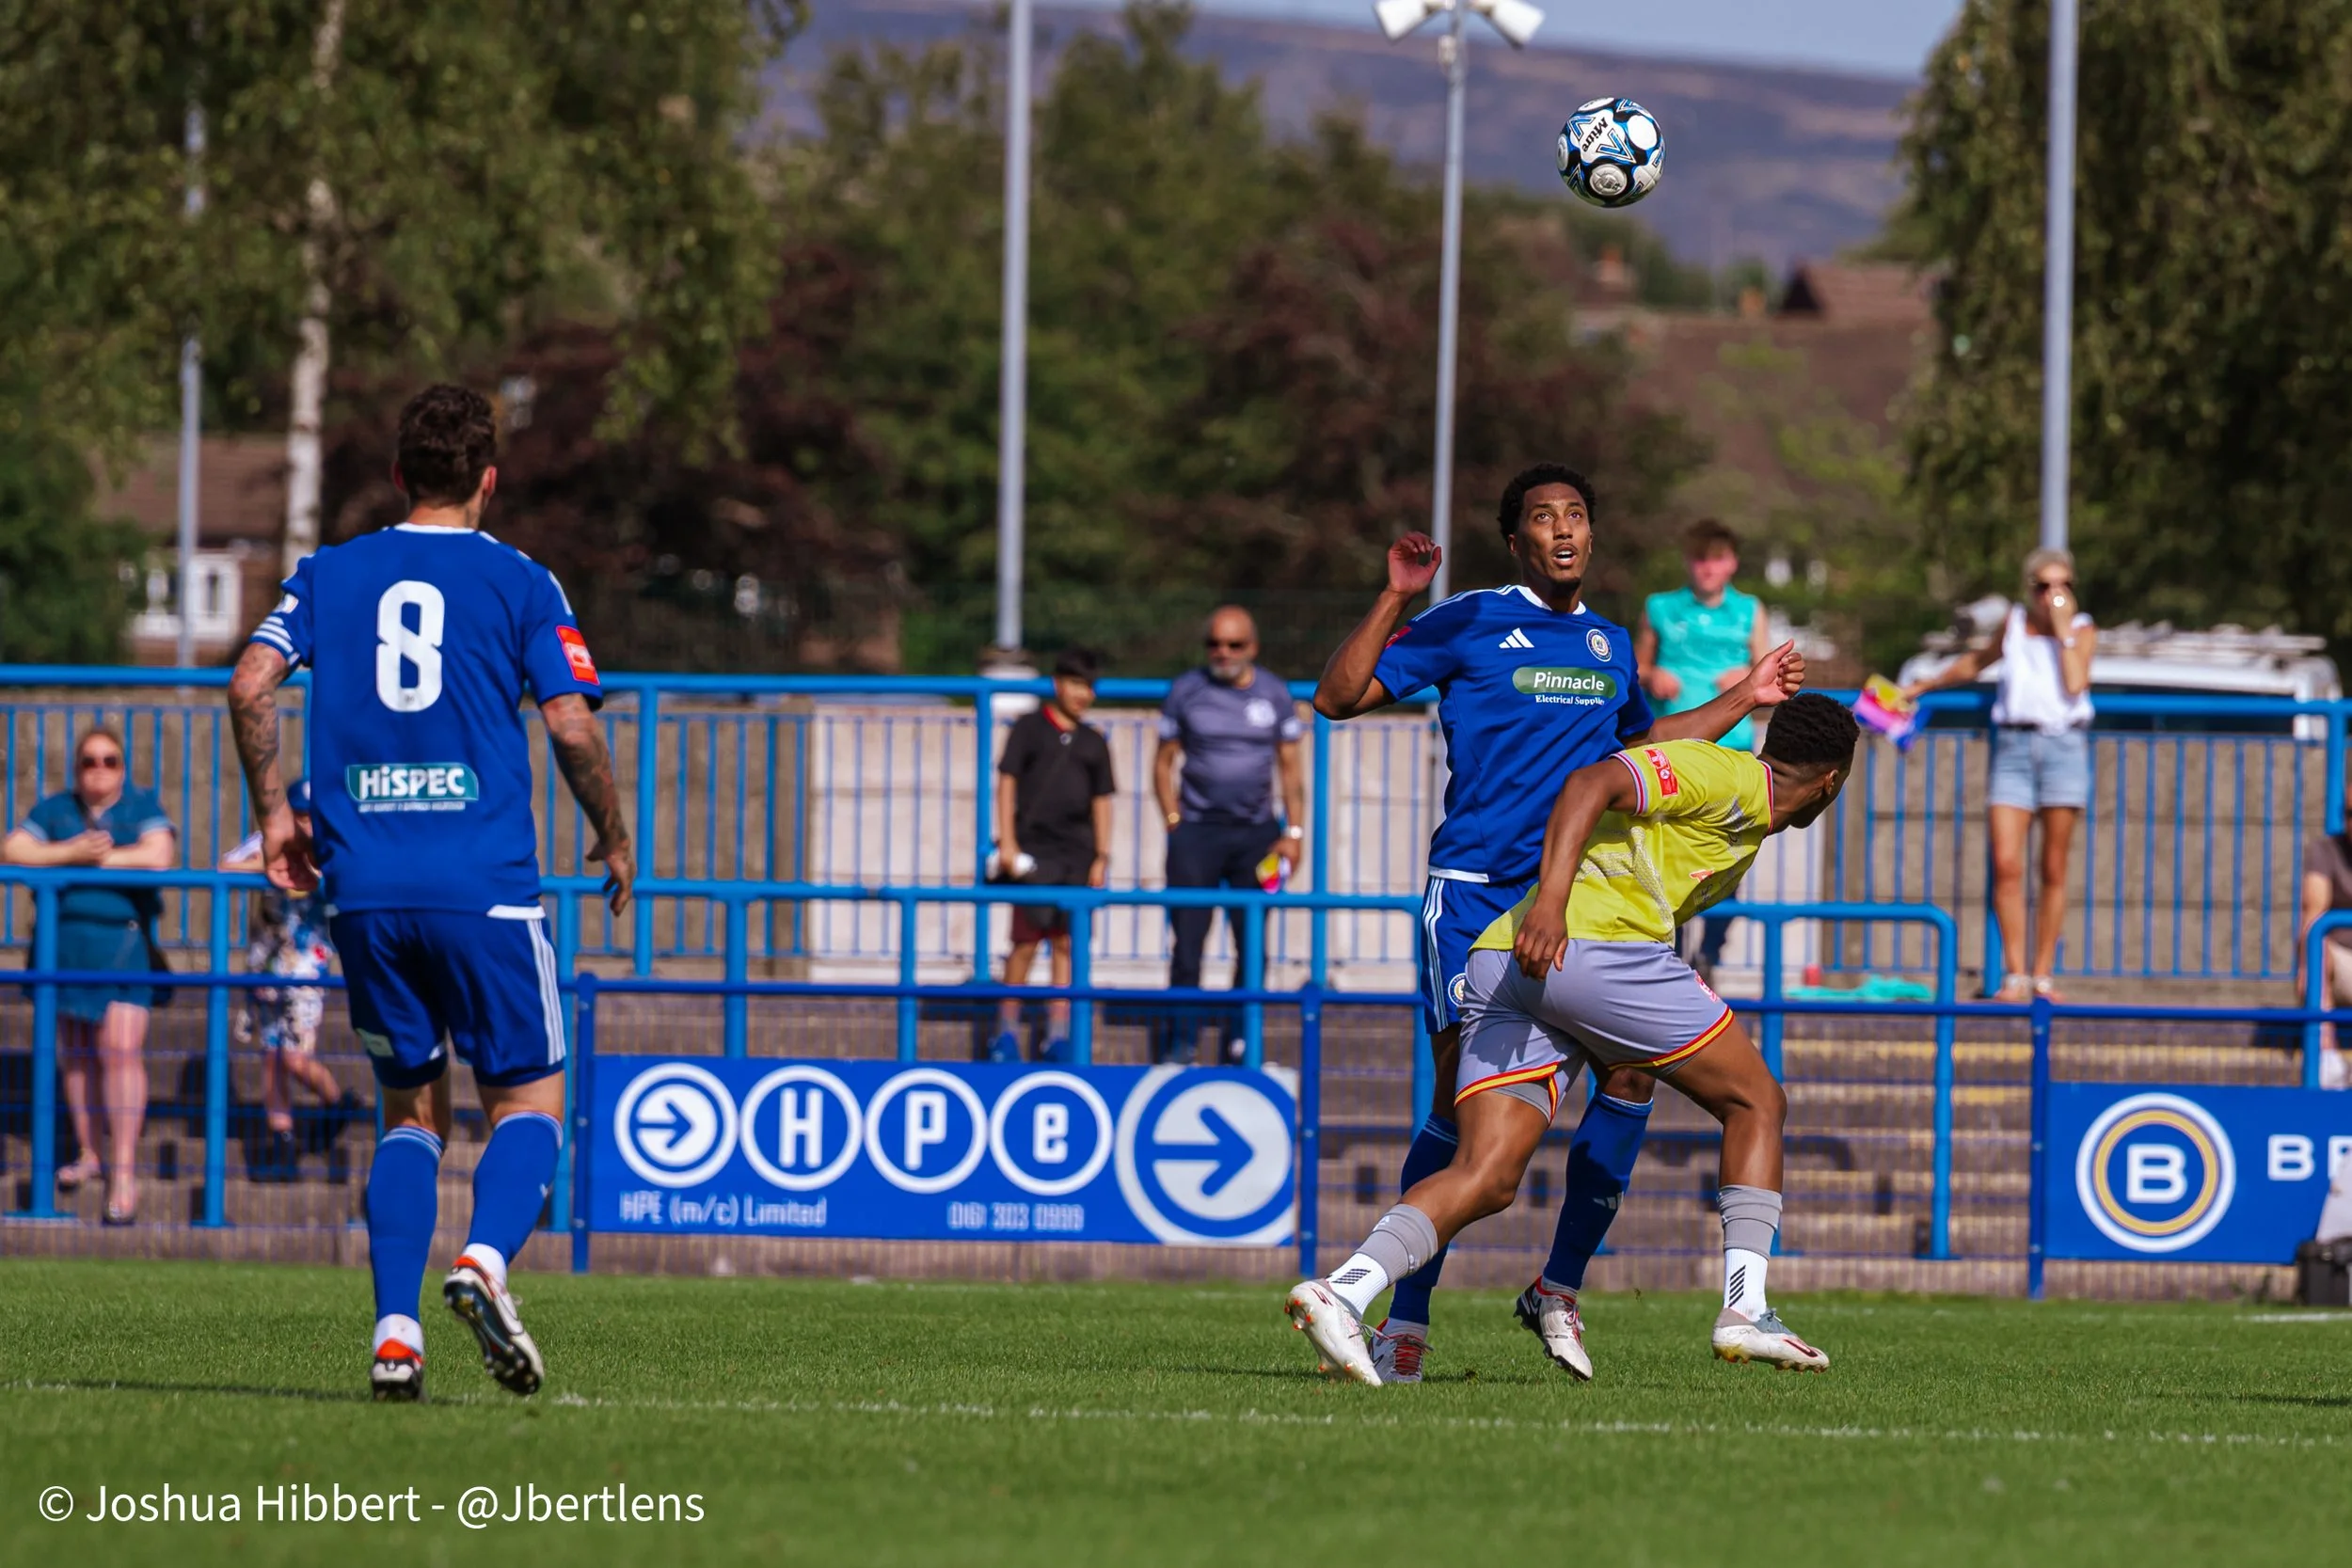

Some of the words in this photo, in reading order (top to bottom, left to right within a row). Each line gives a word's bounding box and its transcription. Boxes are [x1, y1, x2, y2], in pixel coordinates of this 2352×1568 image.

[1581, 117, 1609, 152] Mitre
[376, 579, 445, 712] 8
[1534, 672, 1605, 690] Pinnacle
[1534, 694, 1574, 705] Electrical
[358, 765, 466, 800] HiSPEC
[2126, 1144, 2187, 1204] B
[619, 1190, 663, 1224] HPE
[669, 1192, 739, 1227] (m/c)
[743, 1194, 827, 1227] Limited
